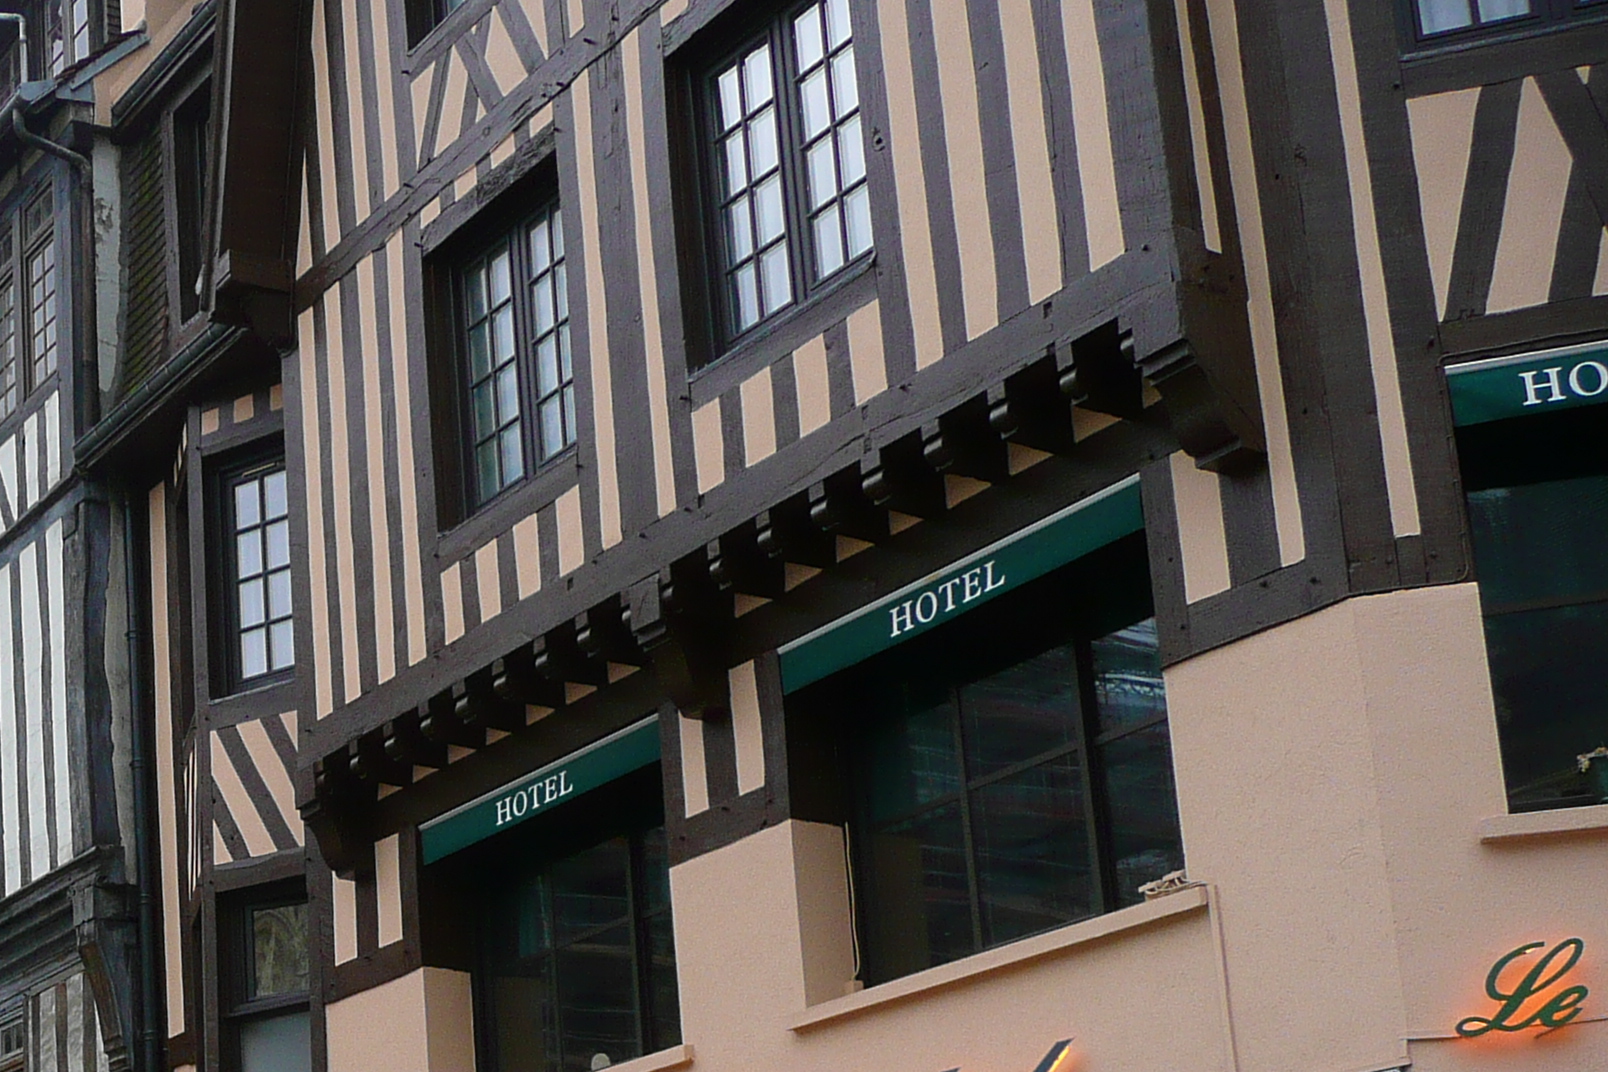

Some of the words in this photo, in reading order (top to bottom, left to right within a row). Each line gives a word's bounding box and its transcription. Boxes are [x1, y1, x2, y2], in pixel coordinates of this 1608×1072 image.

[889, 560, 1006, 638] HOTEL
[494, 771, 574, 826] HOTEL
[1455, 937, 1590, 1037] Le
